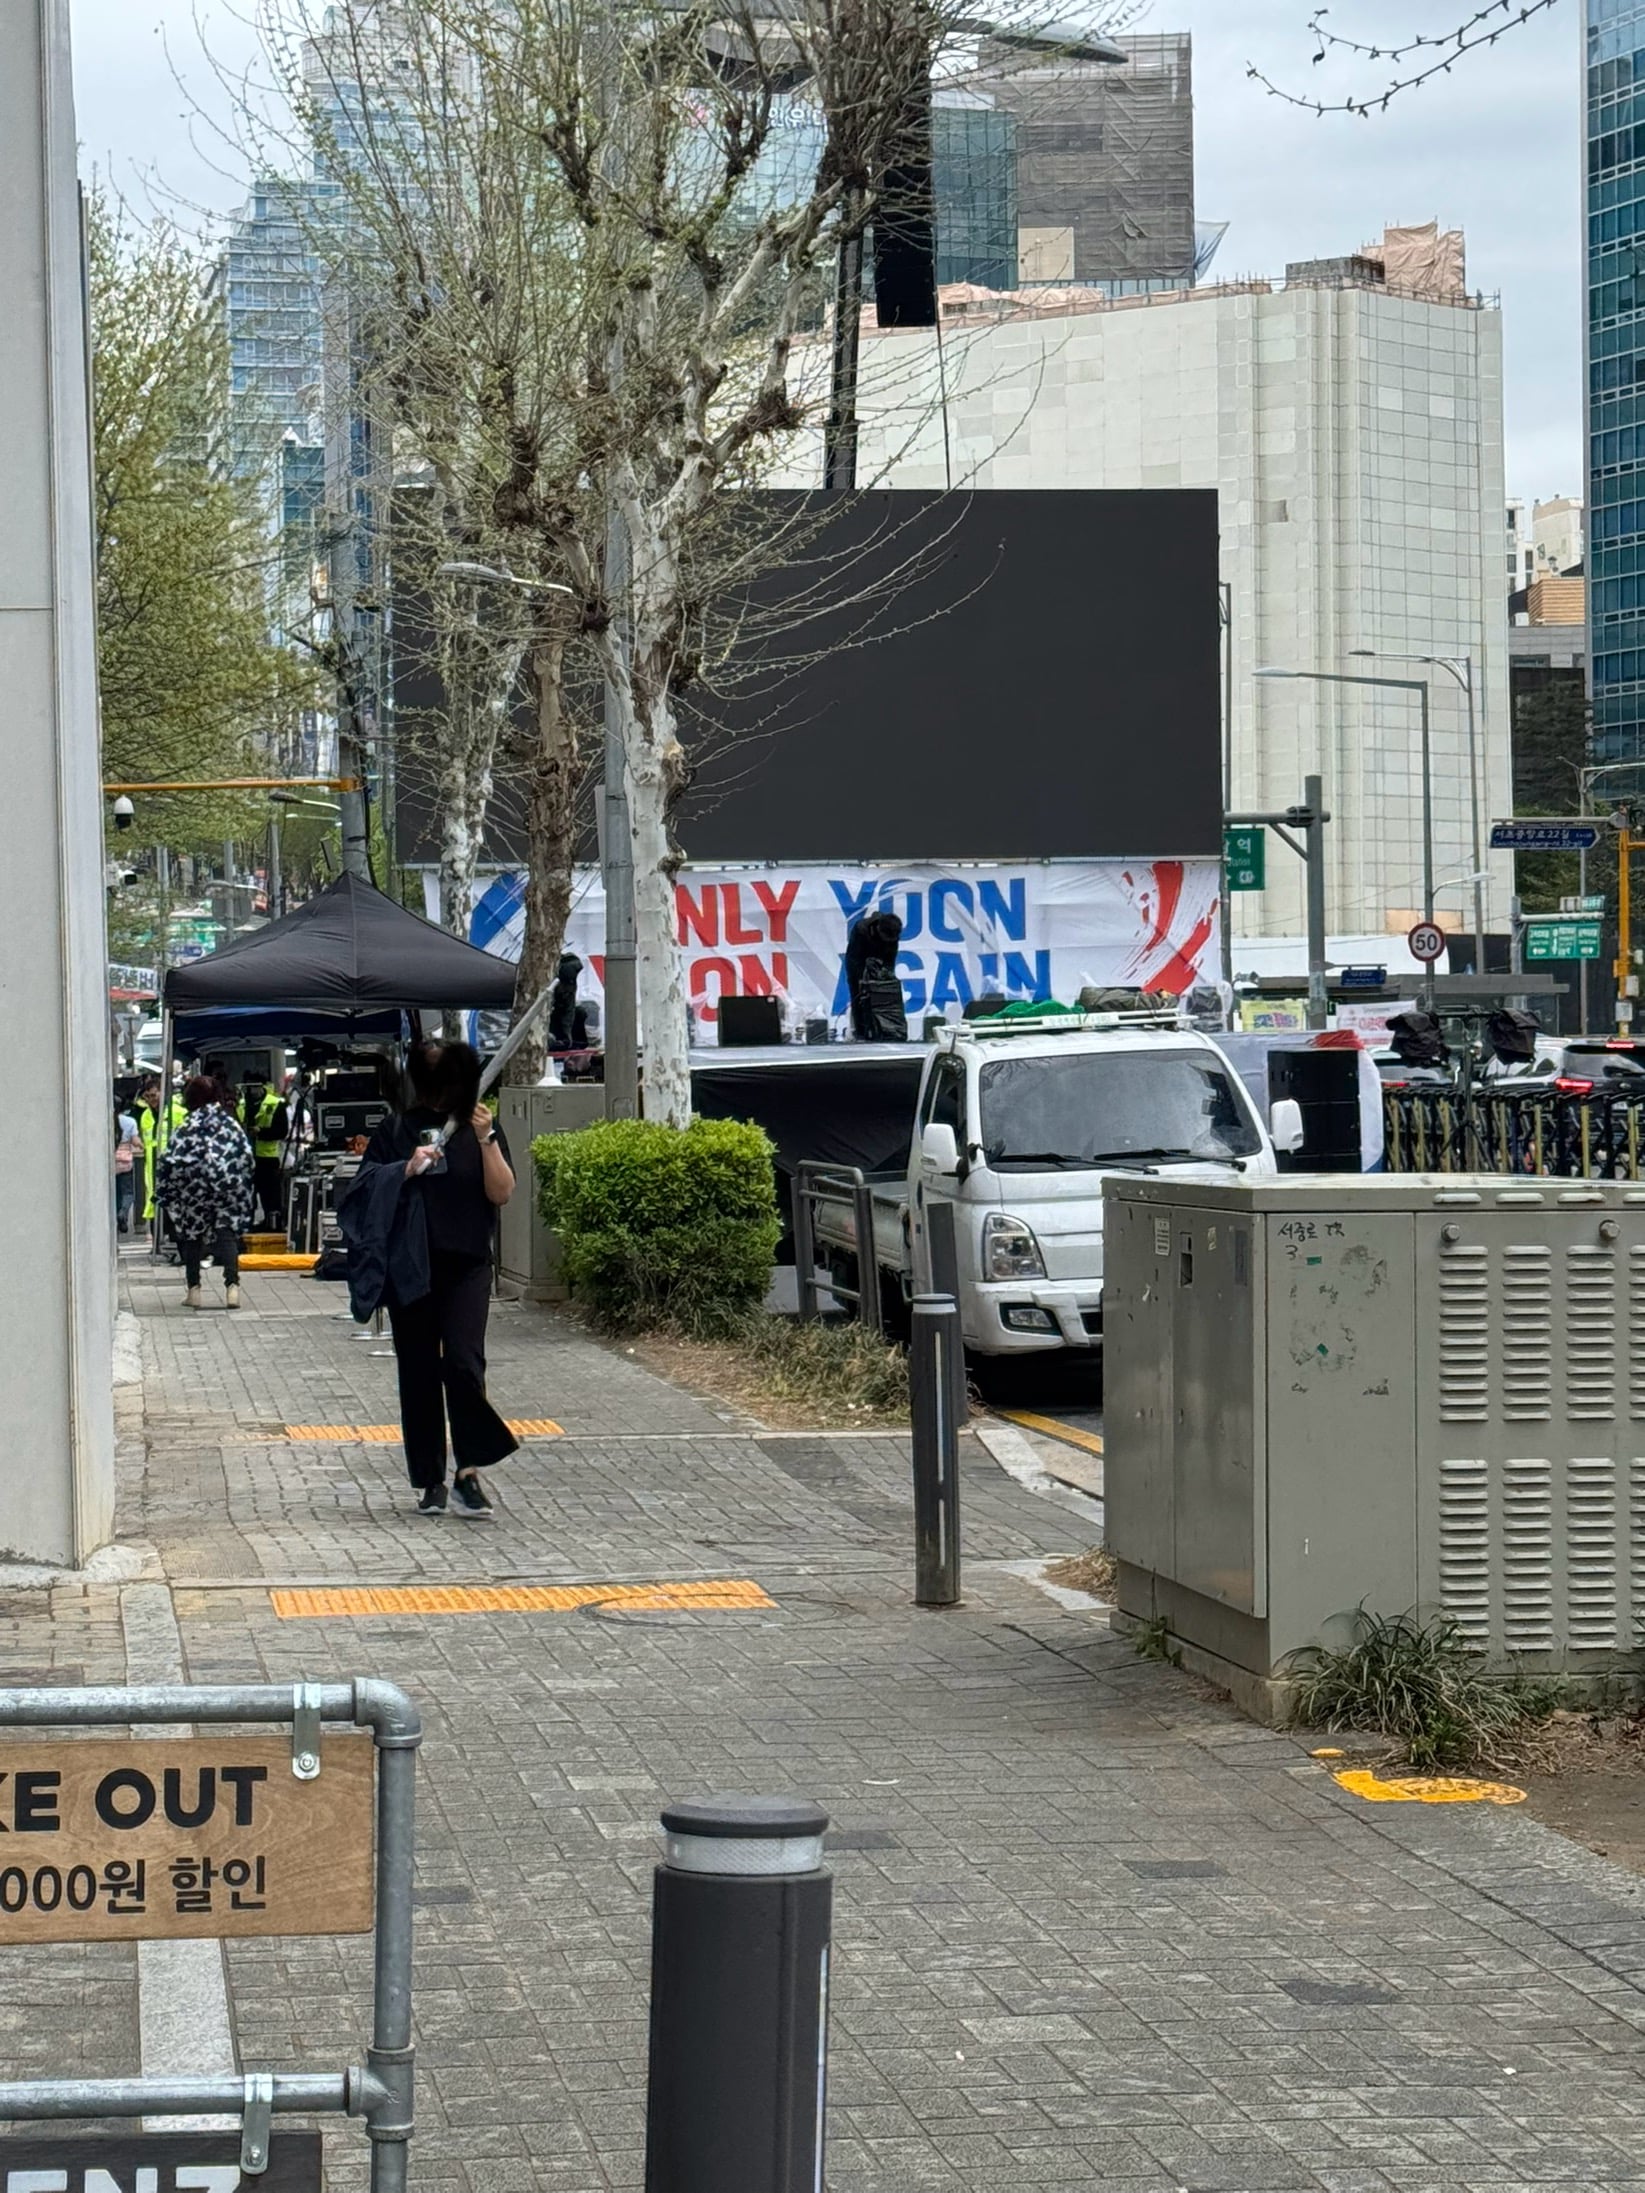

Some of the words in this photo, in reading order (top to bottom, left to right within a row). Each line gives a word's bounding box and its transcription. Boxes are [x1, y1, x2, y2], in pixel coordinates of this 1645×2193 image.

[827, 877, 1026, 943] YOON
[1415, 933, 1438, 952] 50
[94, 1765, 268, 1831] OUT
[0, 1858, 147, 1915] 000원
[168, 1854, 267, 1914] 할인
